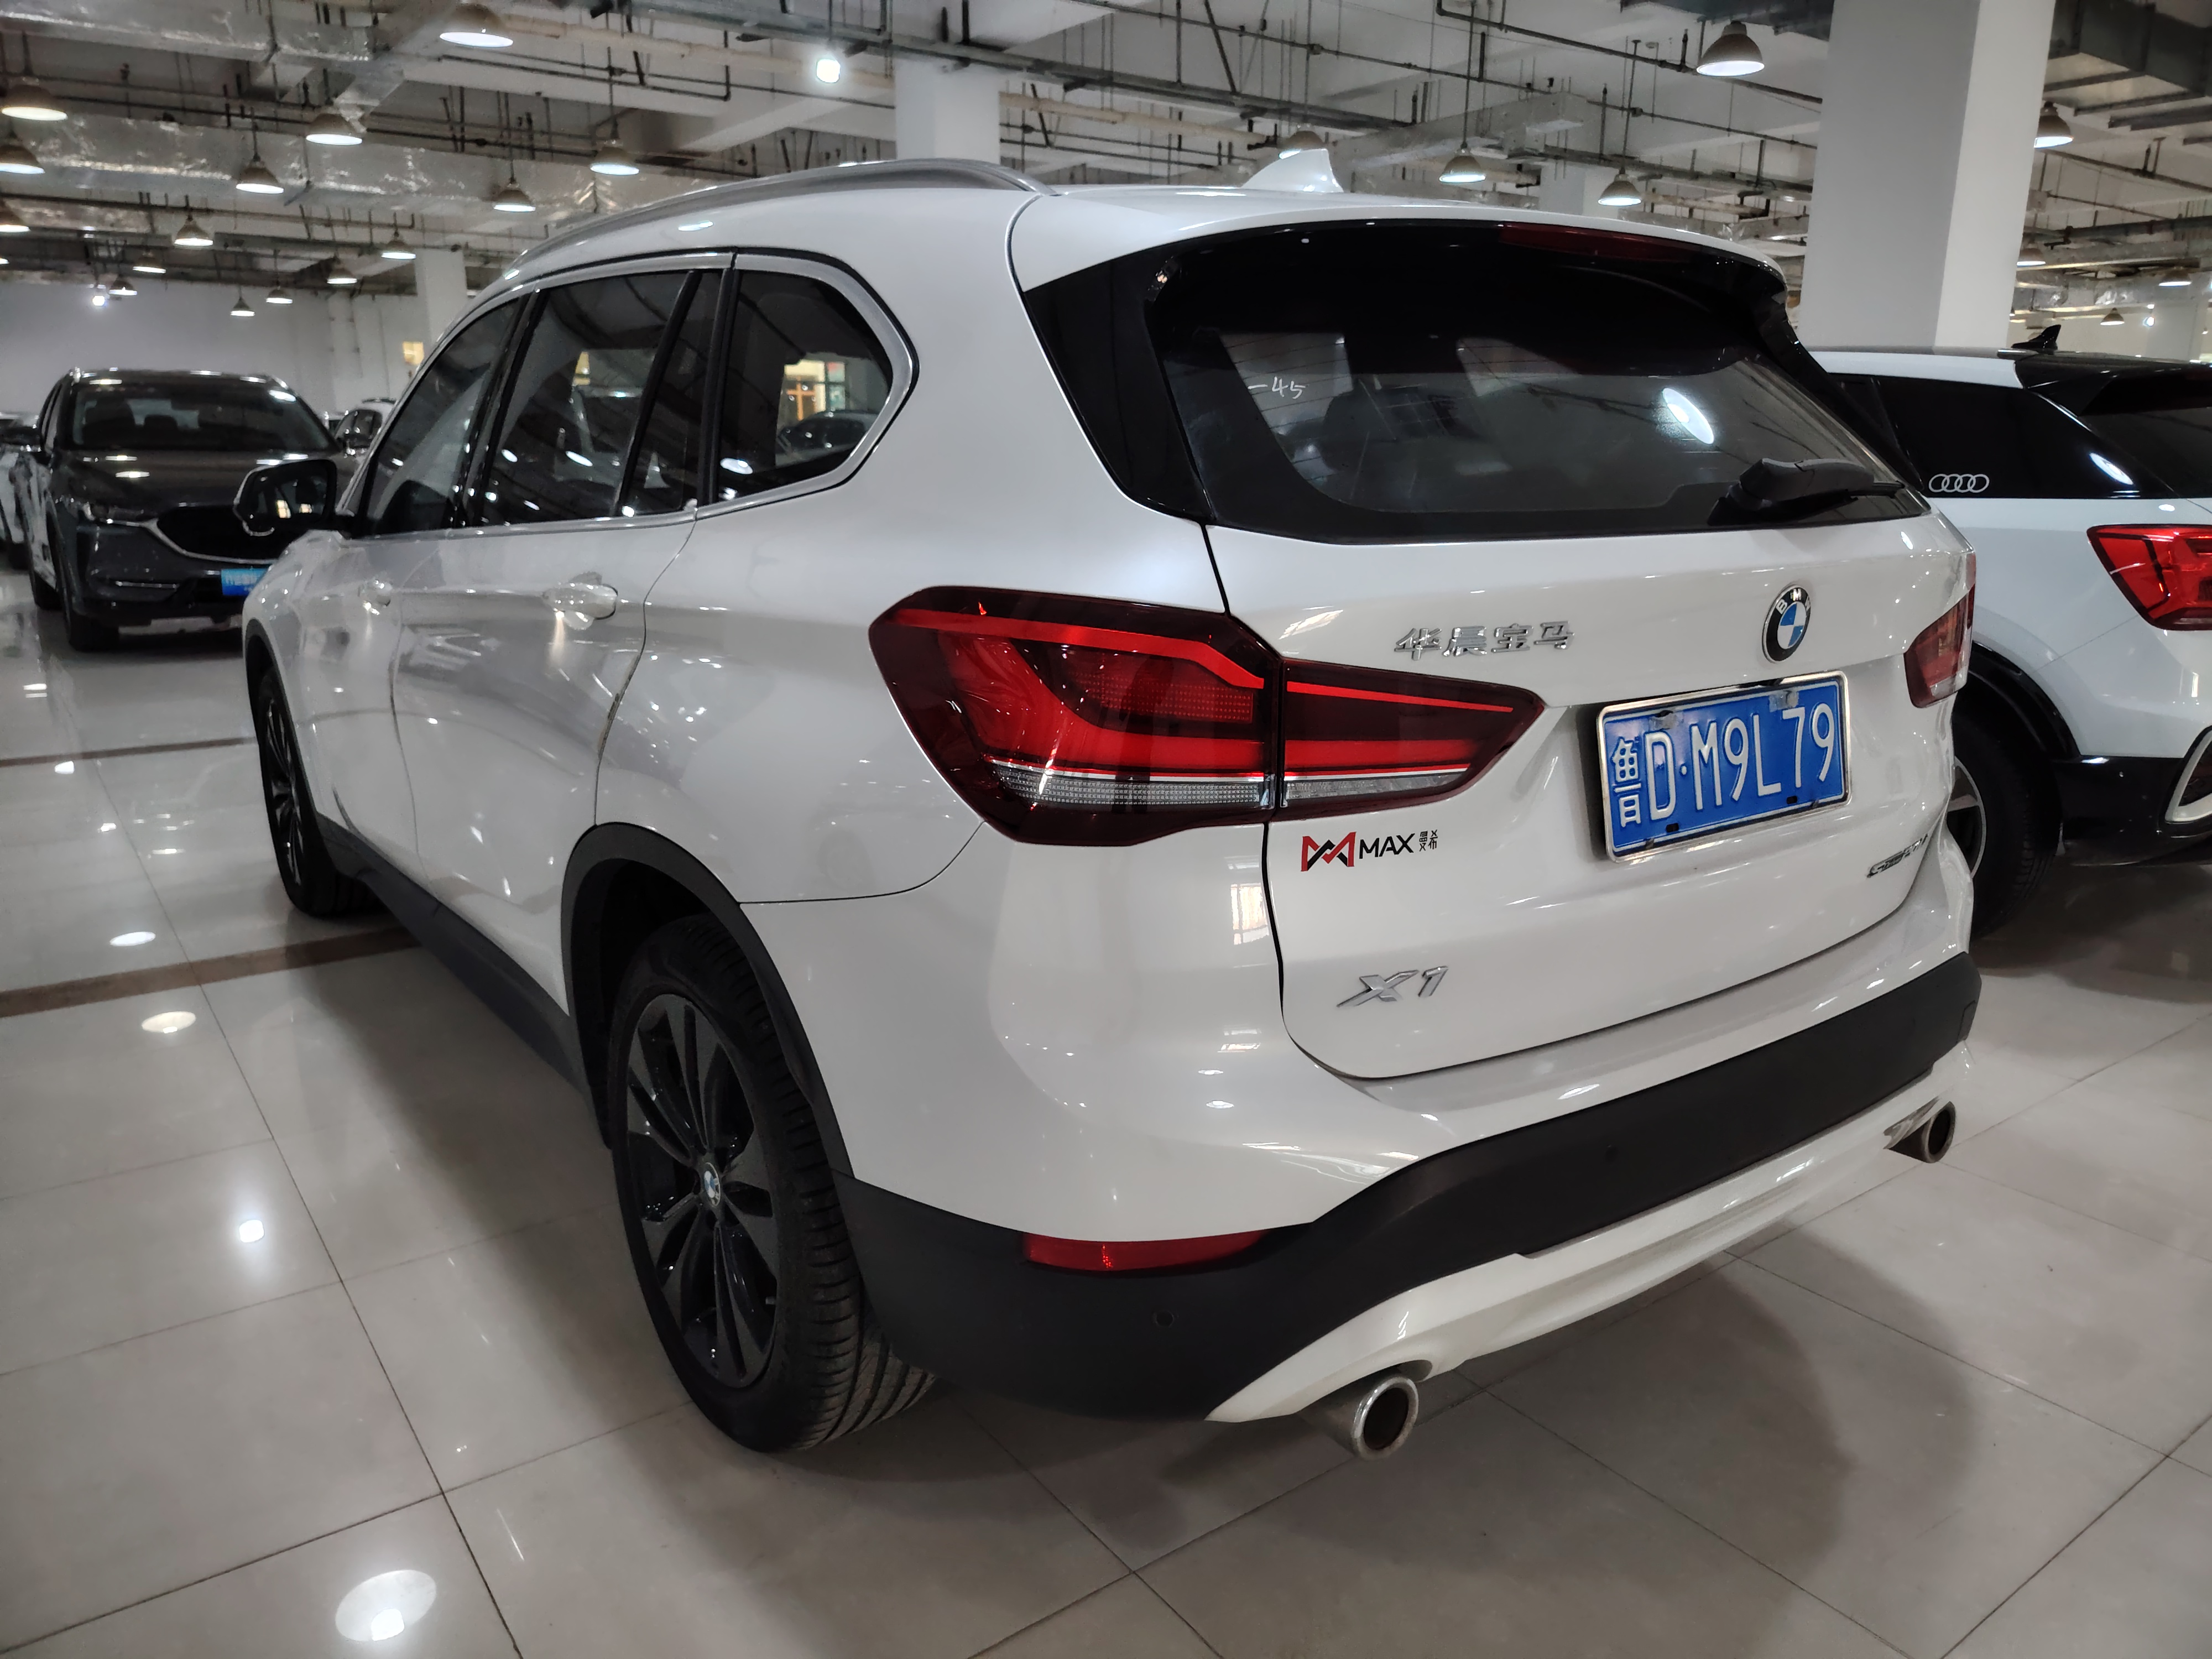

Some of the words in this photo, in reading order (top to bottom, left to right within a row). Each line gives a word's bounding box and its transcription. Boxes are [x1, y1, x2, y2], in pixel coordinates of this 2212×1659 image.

[1775, 588, 1811, 614] BMW
[1394, 620, 1575, 661] 华晨宝马
[1359, 833, 1416, 859] MAX
[1336, 965, 1449, 1008] X1
